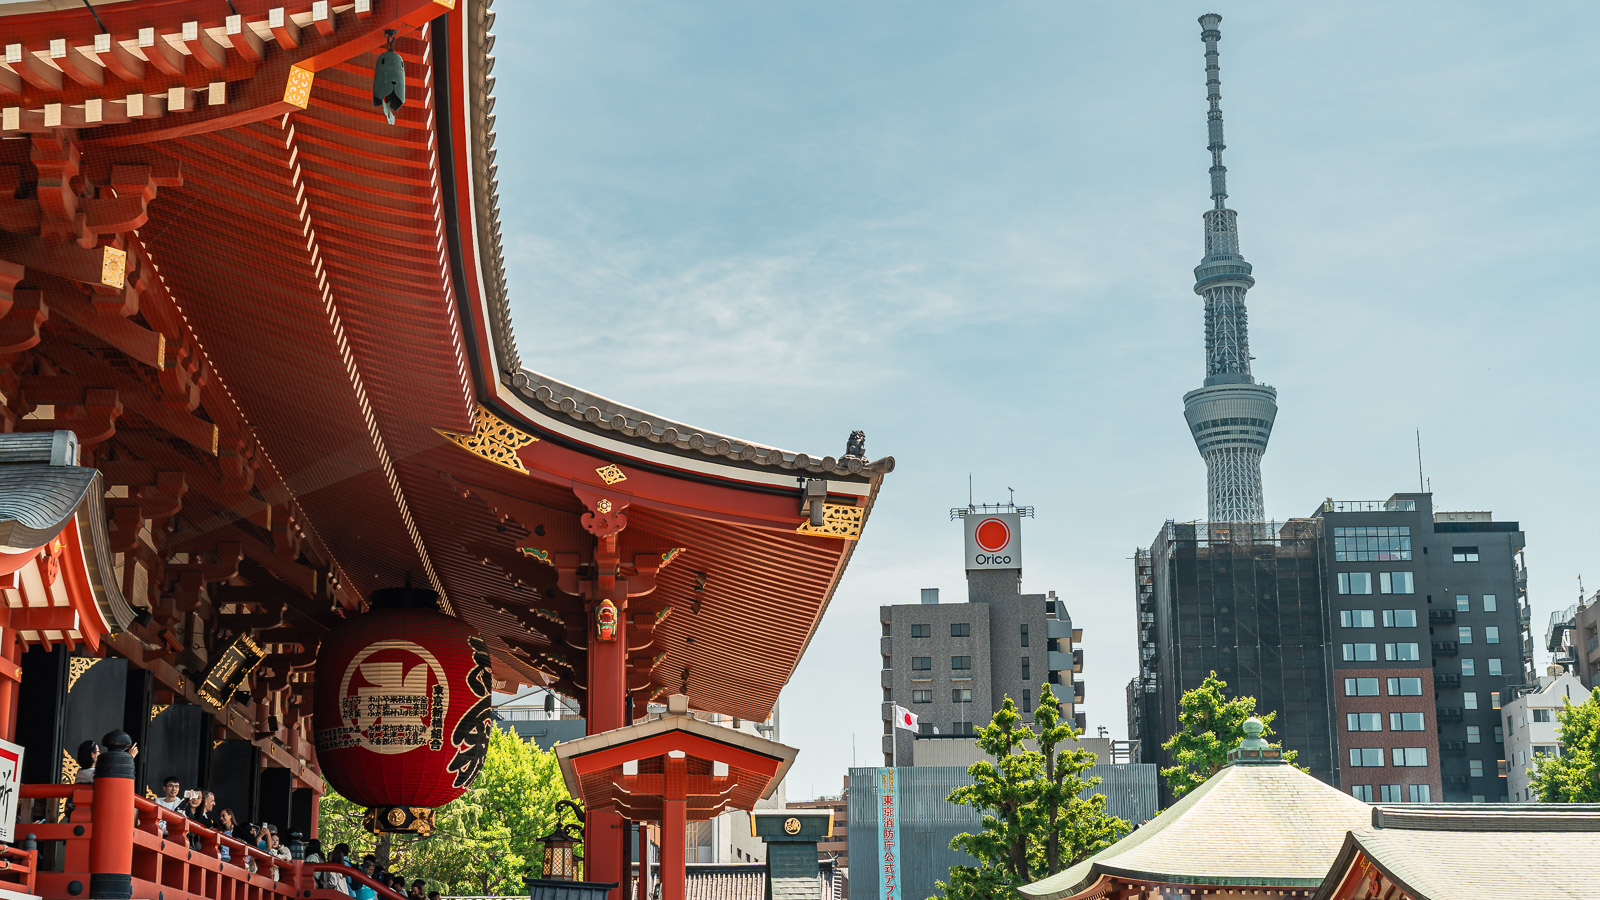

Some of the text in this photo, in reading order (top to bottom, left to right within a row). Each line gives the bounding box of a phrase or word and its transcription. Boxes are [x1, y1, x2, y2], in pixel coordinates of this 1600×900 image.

[975, 554, 1011, 565] Orico
[430, 685, 444, 750] 東京新橋組合
